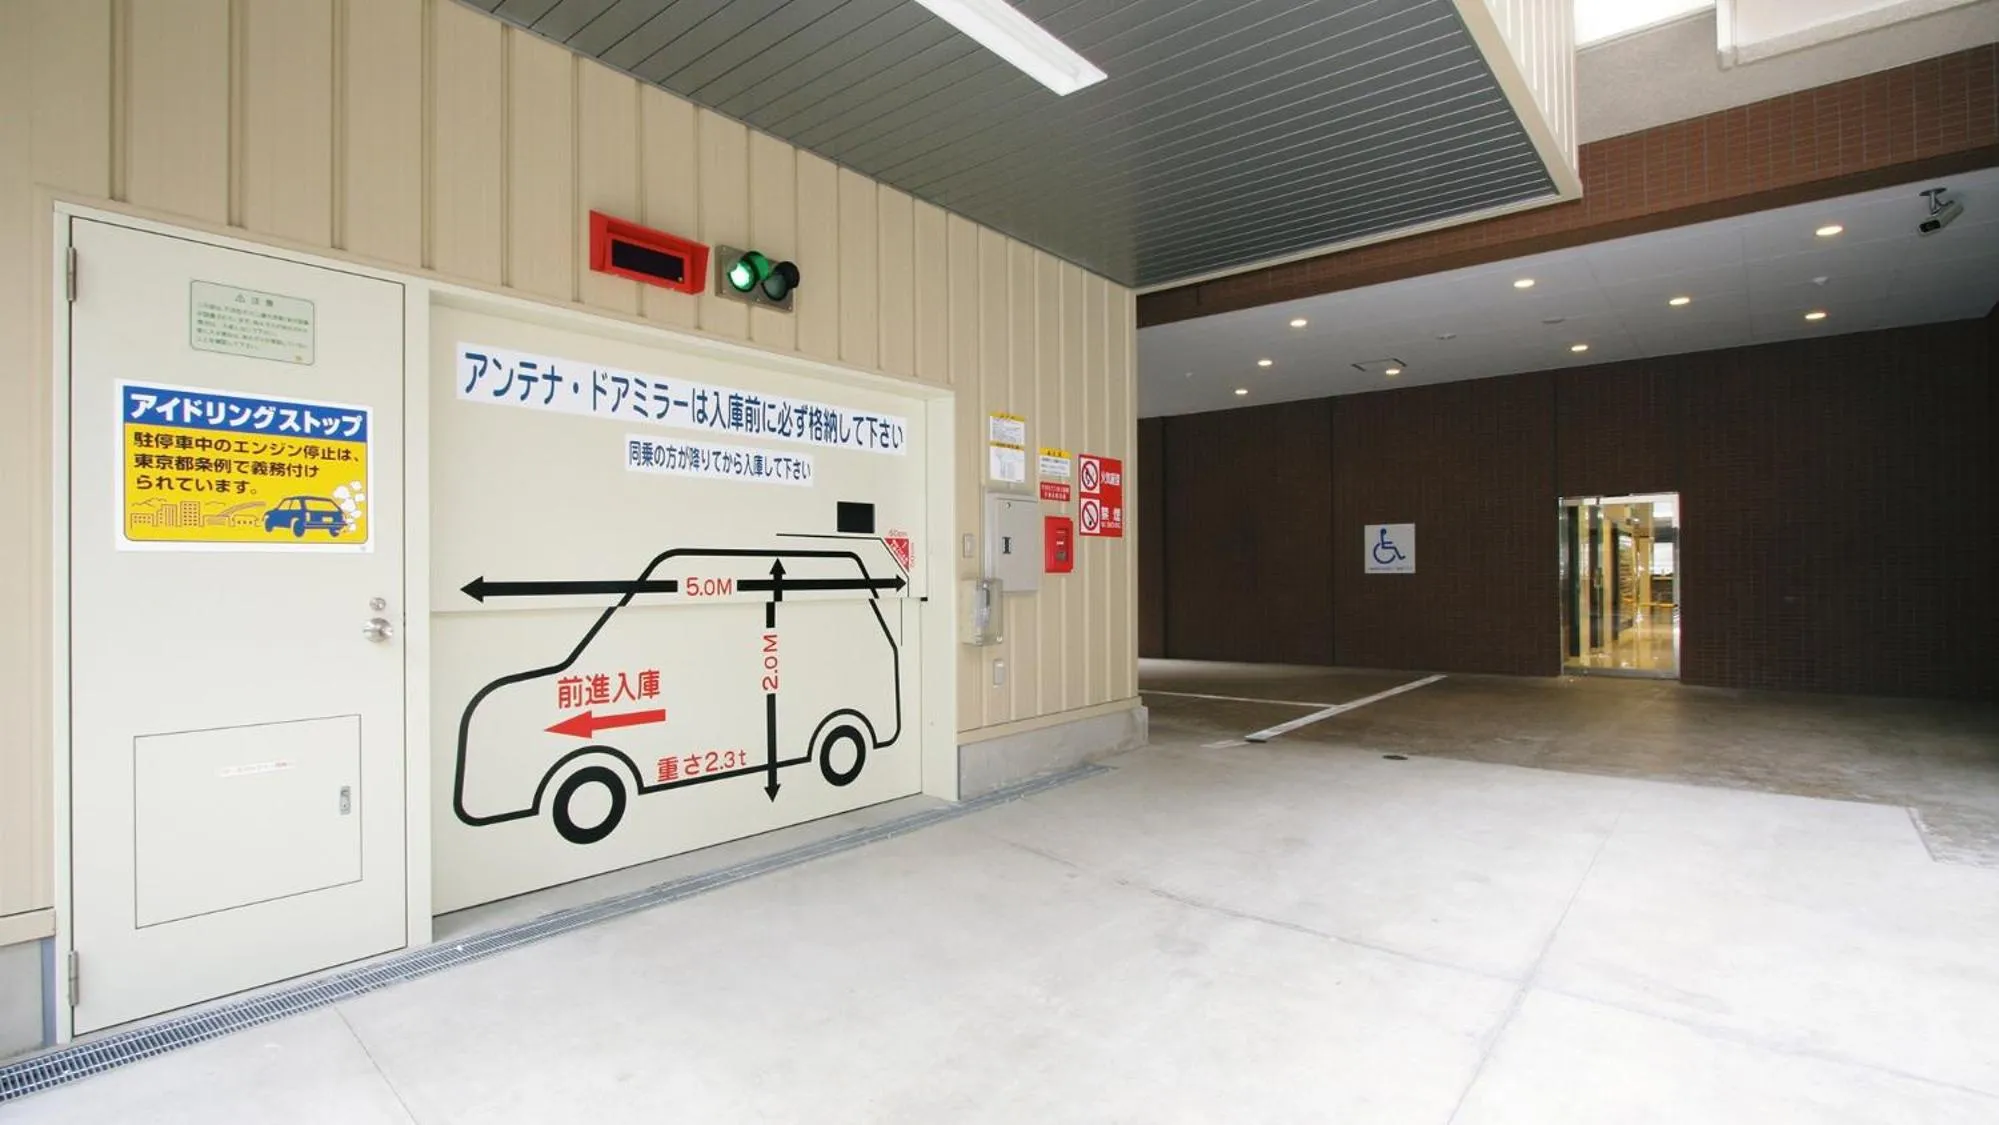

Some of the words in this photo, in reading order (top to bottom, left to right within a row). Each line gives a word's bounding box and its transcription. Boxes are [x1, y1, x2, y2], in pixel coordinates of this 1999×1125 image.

[129, 393, 363, 437] アイドリングストップ
[465, 352, 904, 449] アンテナ・ドアミラーは入庫前に必ず格納して下さい
[133, 431, 360, 463] 駐停車中のエンジン停止は、
[133, 453, 320, 478] 東京都条例で義務付け
[629, 440, 811, 480] 同乗の方が降りてから入庫して下さい
[135, 475, 258, 496] られています。
[686, 577, 732, 596] 5.0M
[762, 634, 778, 690] 2.0M
[557, 669, 661, 709] 前進入庫
